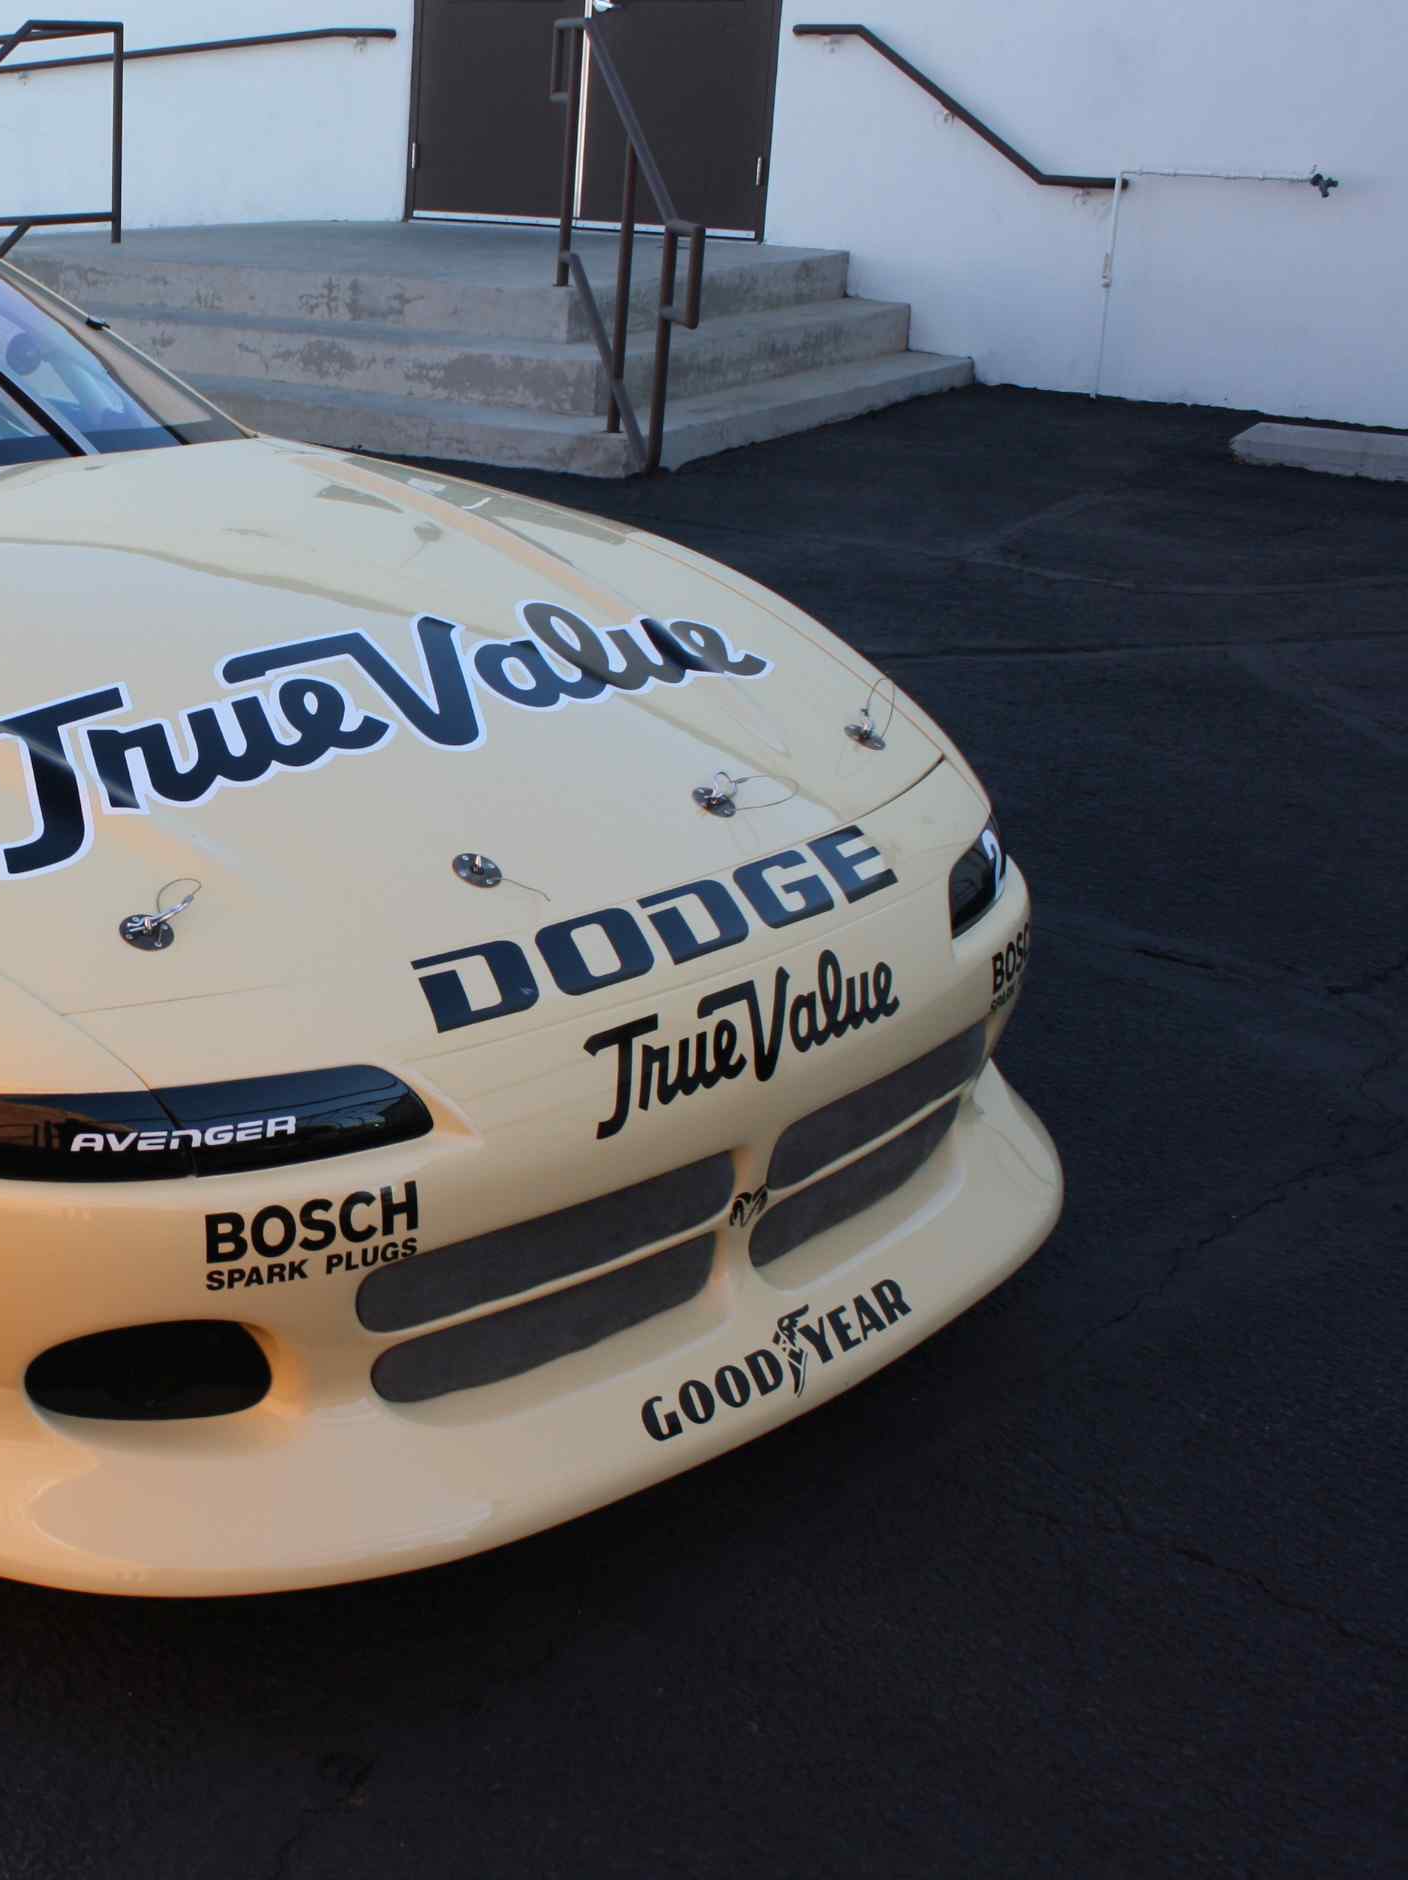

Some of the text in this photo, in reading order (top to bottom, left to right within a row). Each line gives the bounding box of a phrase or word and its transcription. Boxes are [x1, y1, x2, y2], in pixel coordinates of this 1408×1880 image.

[410, 825, 897, 1033] DODGE
[70, 1115, 297, 1153] AVENGER
[205, 1180, 418, 1264] BOSCH
[206, 1237, 418, 1291] SPARK PLUGS
[641, 1278, 912, 1442] GOODYEAR
